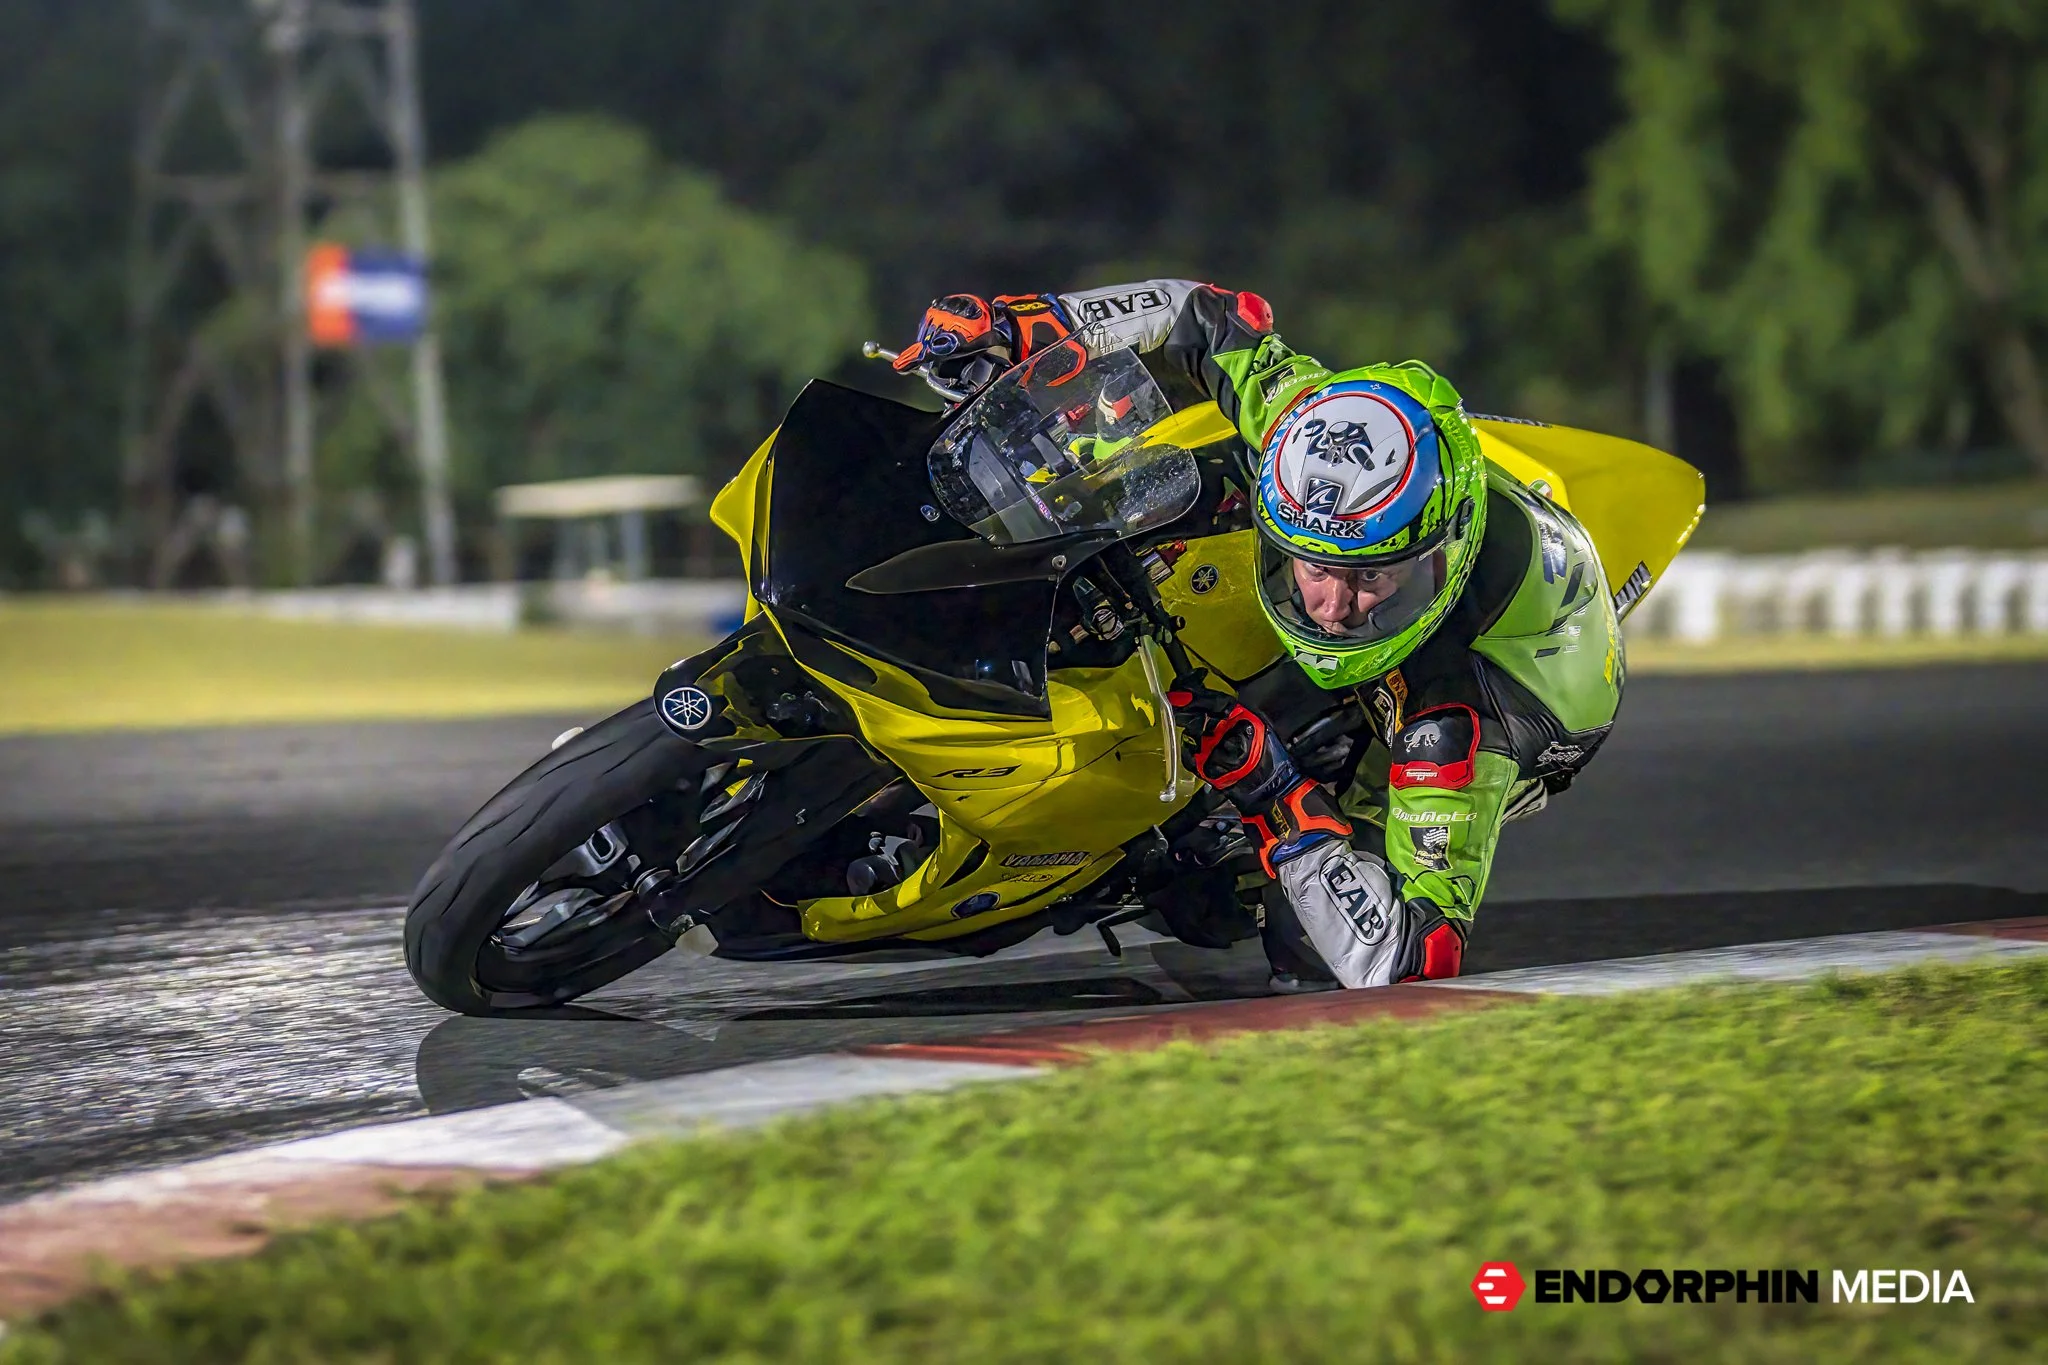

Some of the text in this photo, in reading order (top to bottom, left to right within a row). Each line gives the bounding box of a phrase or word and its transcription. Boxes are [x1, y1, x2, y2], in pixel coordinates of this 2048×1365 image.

[1084, 289, 1164, 322] EAB
[1277, 502, 1367, 539] SHARK
[1324, 863, 1385, 940] EAB
